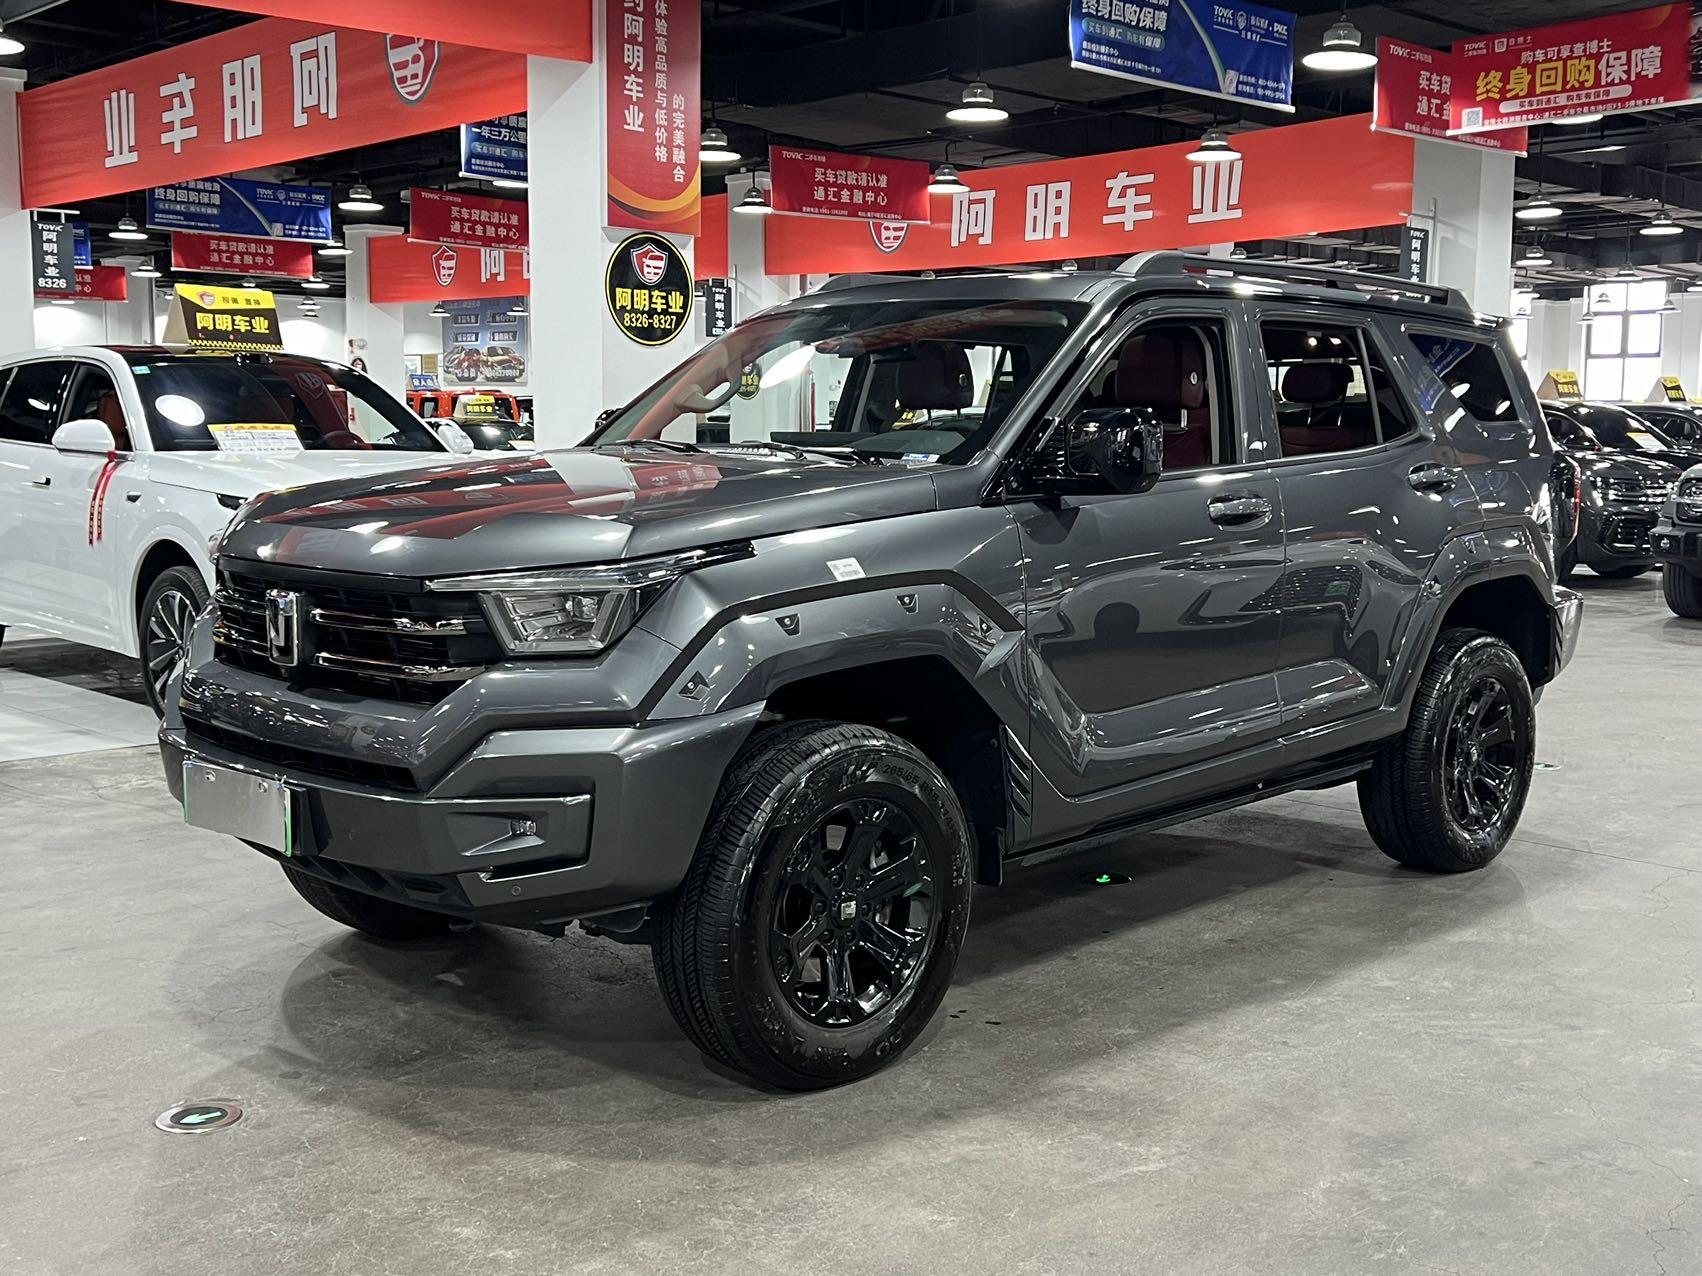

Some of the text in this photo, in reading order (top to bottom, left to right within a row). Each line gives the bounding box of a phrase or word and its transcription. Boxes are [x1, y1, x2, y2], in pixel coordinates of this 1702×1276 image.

[1520, 38, 1613, 65] 购车可享查博士
[655, 0, 668, 163] 体验高品质与低价格
[1475, 45, 1662, 102] 终身回购保障
[672, 93, 686, 183] 的完美融合
[814, 167, 888, 188] 买车贷款请认准
[813, 186, 888, 206] 通汇金融中心
[950, 160, 1243, 248] 阿明车业
[450, 206, 519, 226] 买车贷款请认准
[450, 221, 520, 240] 通汇金融中心
[42, 231, 60, 278] 阿明车业
[38, 278, 67, 289] 8326
[615, 287, 684, 313] 阿明车业
[196, 312, 270, 334] 阿明车业
[624, 312, 677, 329] 8326-8327
